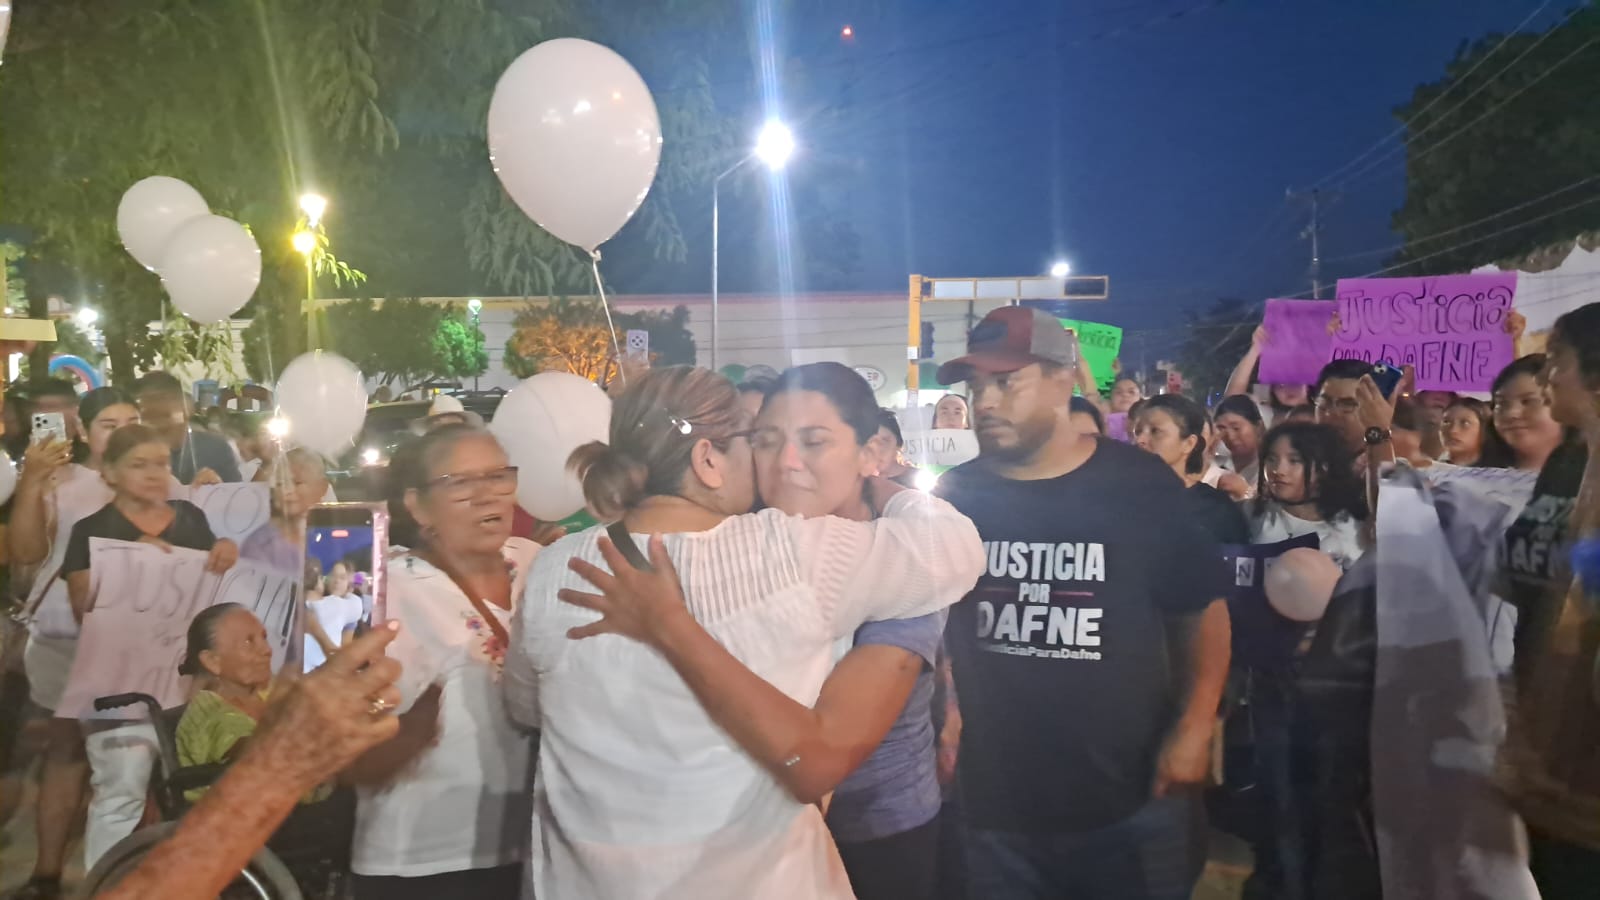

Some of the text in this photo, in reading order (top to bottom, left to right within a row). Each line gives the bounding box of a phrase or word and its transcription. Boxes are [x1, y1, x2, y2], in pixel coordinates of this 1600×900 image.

[904, 437, 956, 455] USTICIA
[1019, 582, 1050, 604] POR
[977, 601, 1103, 646] DAFNE
